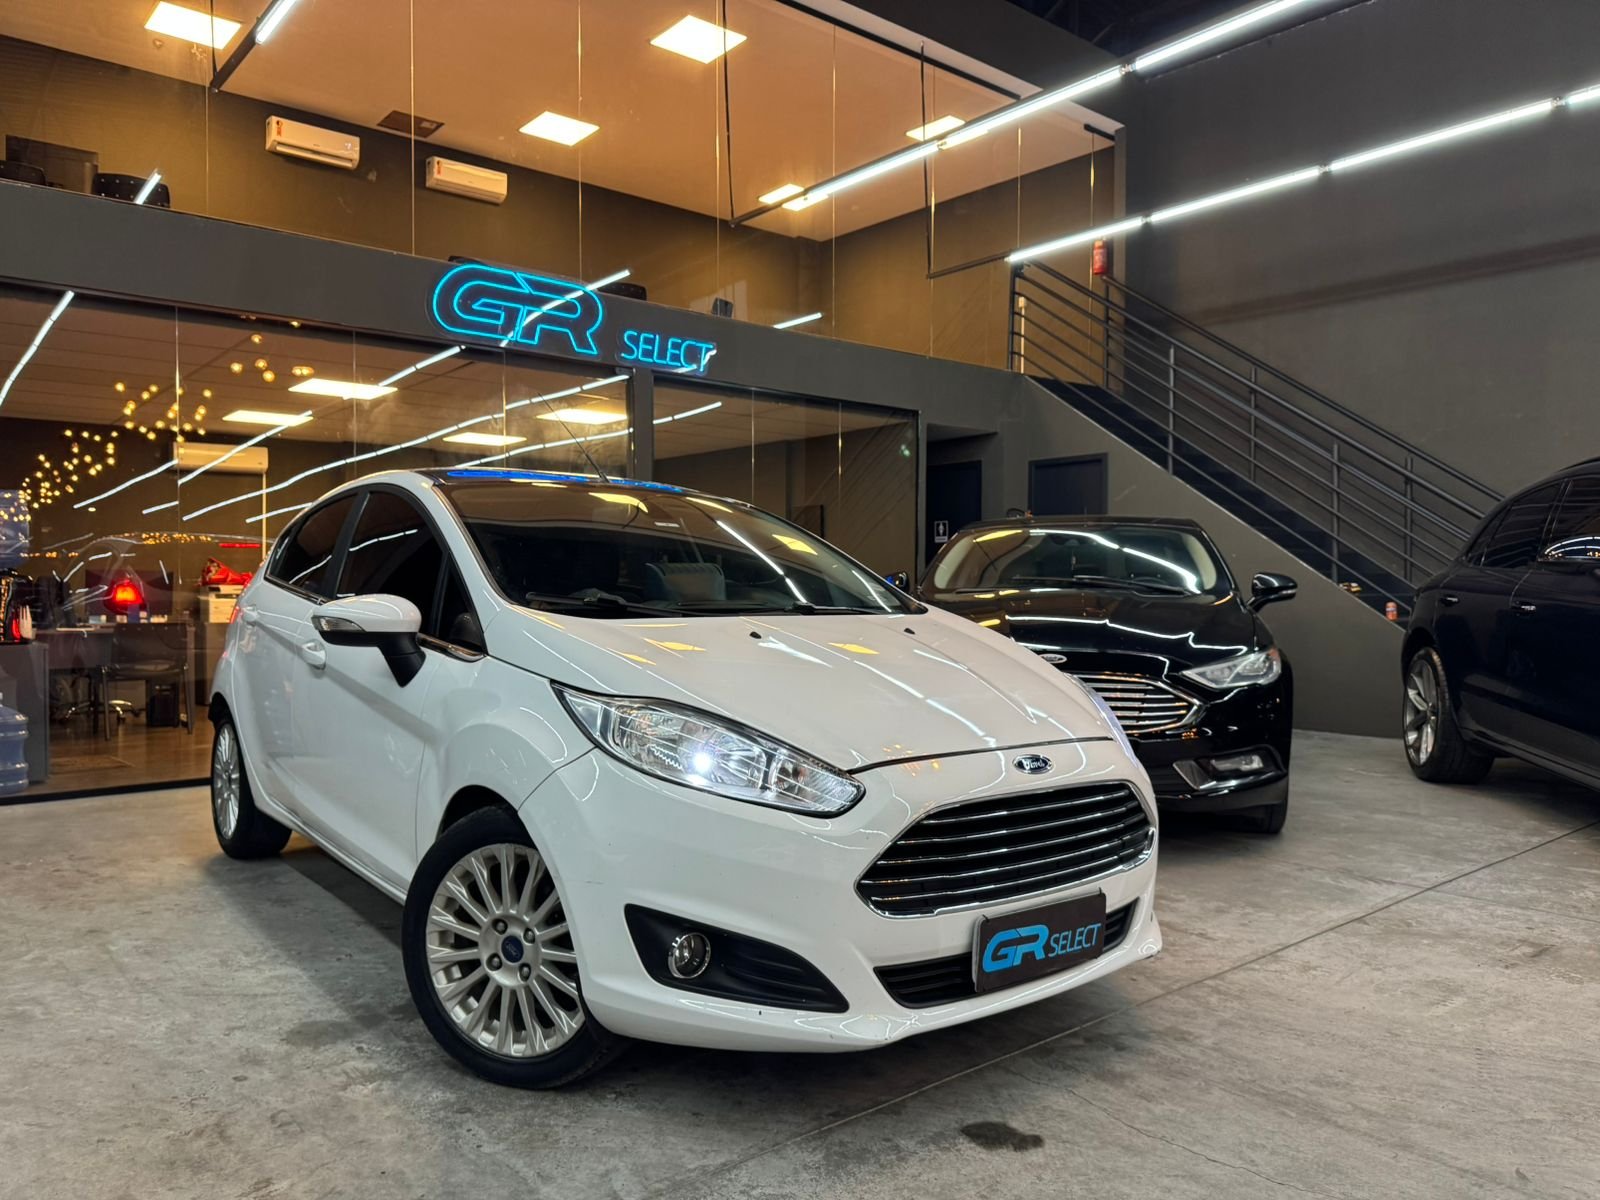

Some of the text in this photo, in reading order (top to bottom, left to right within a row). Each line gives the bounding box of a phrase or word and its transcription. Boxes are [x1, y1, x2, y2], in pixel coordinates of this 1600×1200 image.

[433, 263, 714, 372] GR SELECT
[982, 923, 1102, 973] GR SELECT
